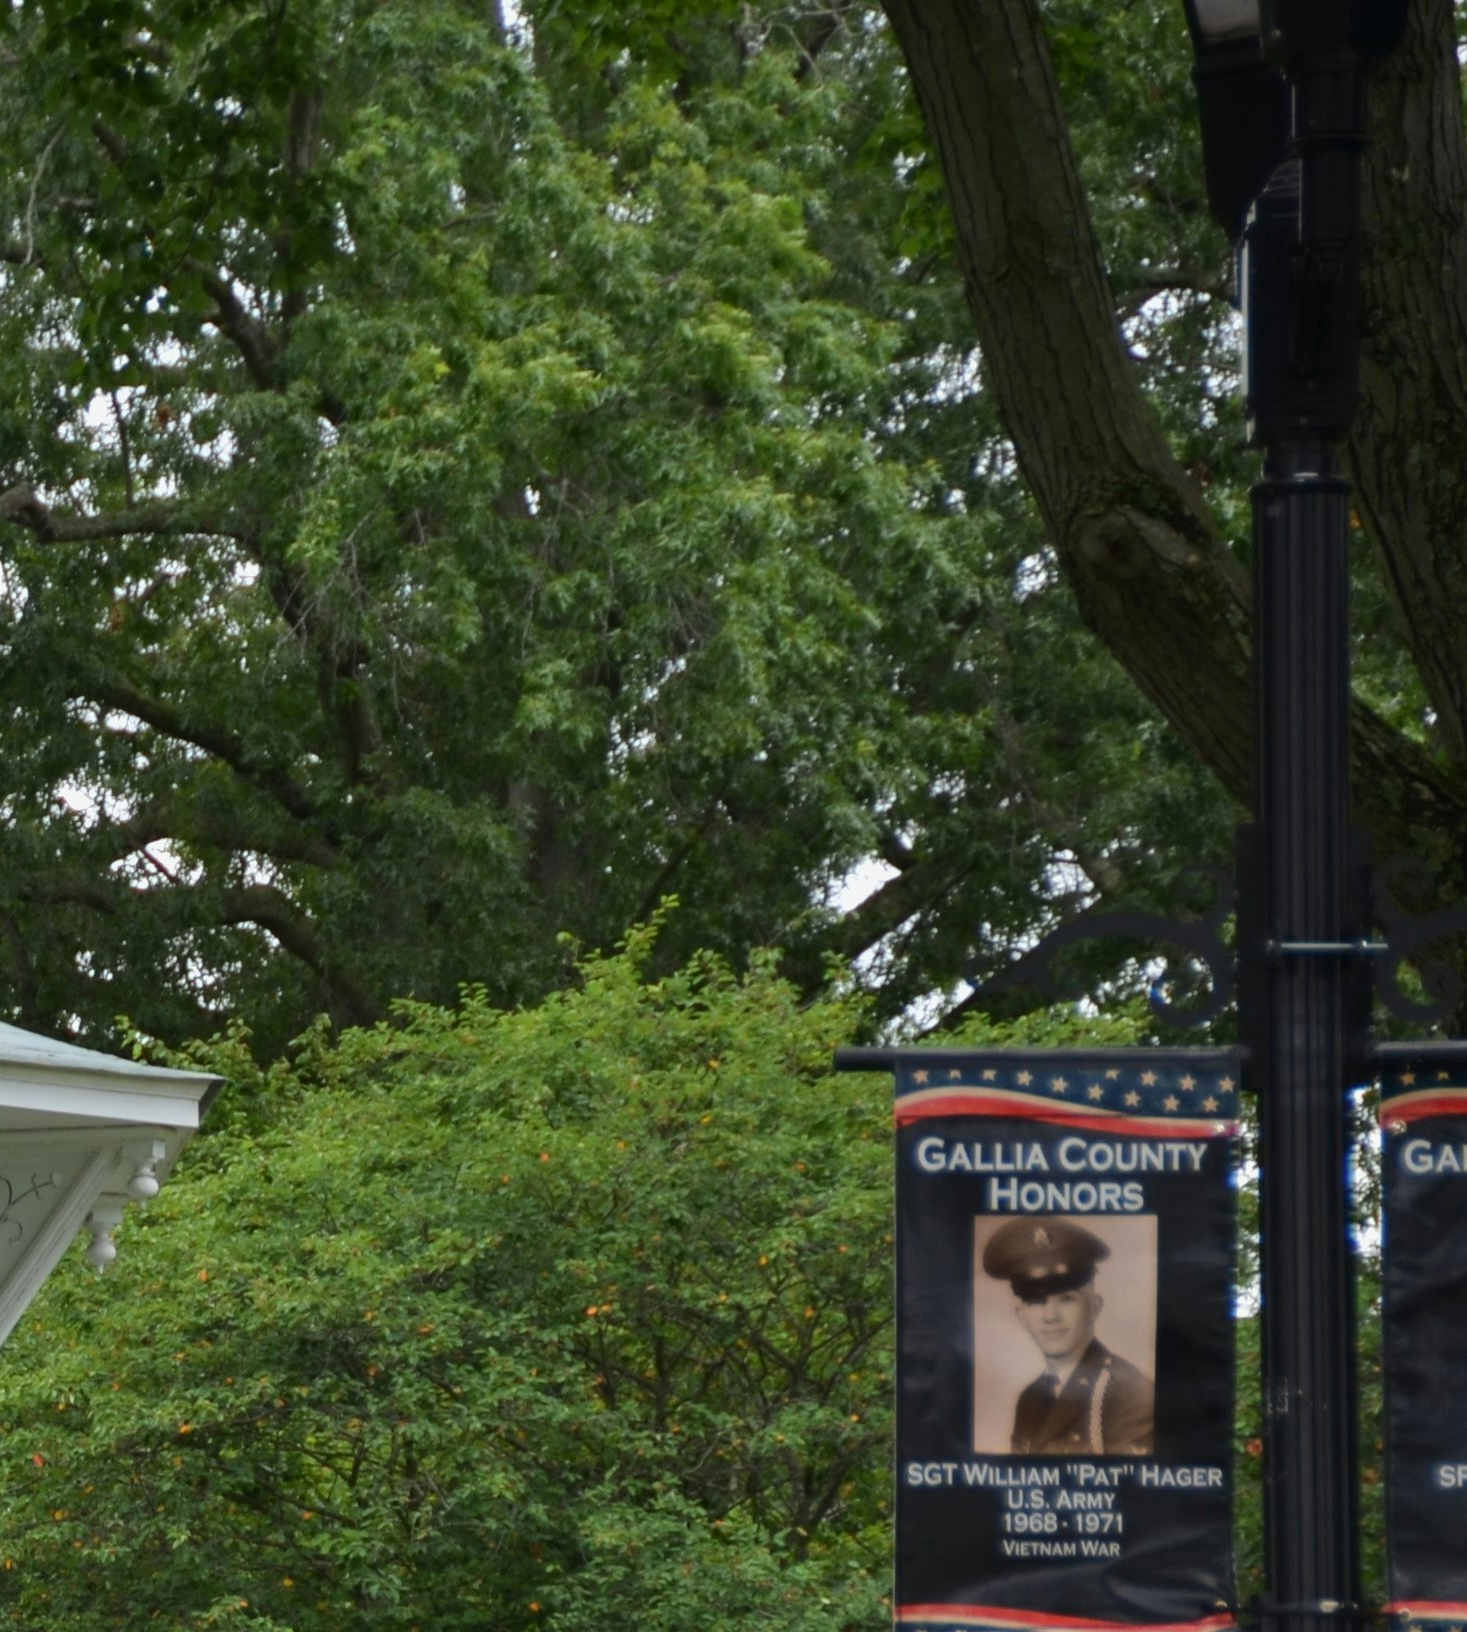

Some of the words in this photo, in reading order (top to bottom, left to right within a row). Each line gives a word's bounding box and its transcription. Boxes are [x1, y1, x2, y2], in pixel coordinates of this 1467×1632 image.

[917, 1136, 1050, 1172] GALLIA
[1057, 1136, 1209, 1172] COUNTY
[1404, 1137, 1467, 1174] GA
[989, 1176, 1145, 1212] HONORS
[906, 1462, 958, 1486] SGT
[963, 1463, 1060, 1487] WILLIAM
[1066, 1463, 1135, 1487] "PAT"
[1141, 1464, 1223, 1488] HAGER
[1007, 1489, 1050, 1510] U.S.
[1056, 1489, 1116, 1510] ARMY
[1003, 1512, 1058, 1534] 1968
[1075, 1512, 1124, 1533] 1971
[1002, 1539, 1077, 1558] VIETNAM
[1080, 1540, 1121, 1558] WAR
